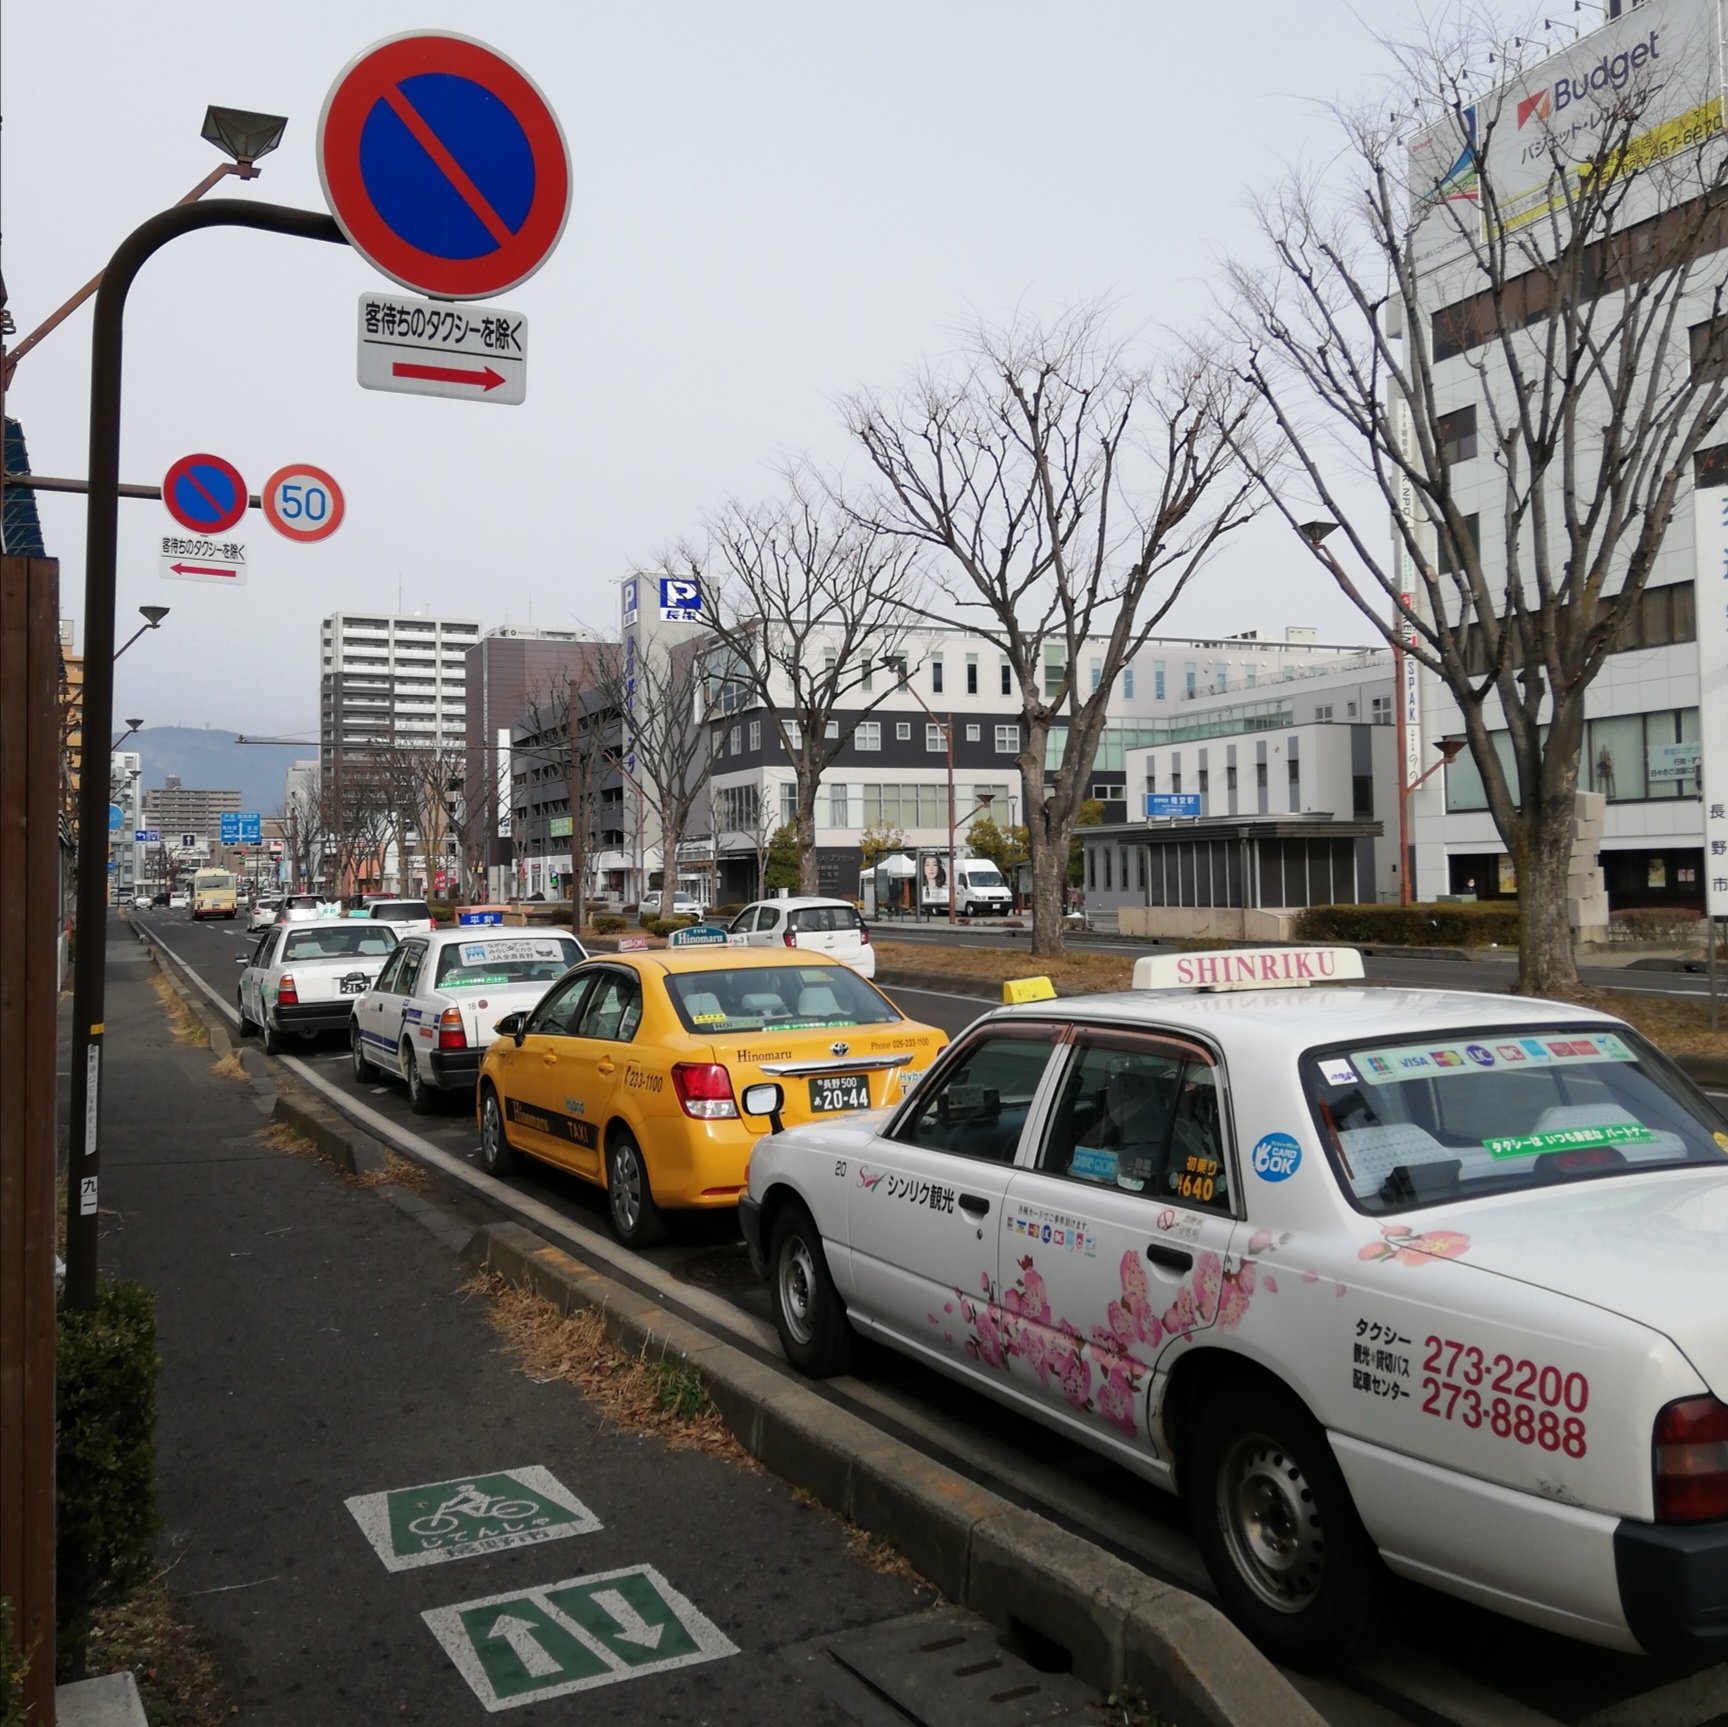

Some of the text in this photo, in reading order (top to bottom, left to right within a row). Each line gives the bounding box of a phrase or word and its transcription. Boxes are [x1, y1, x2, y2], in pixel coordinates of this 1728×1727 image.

[1555, 31, 1659, 112] Budget
[365, 301, 522, 352] 客待ちのタクシーを除く
[282, 484, 326, 521] 50
[162, 537, 245, 561] 客待ちのタクシーを除く
[667, 580, 697, 607] P
[1408, 662, 1416, 721] SPAK
[1709, 805, 1728, 892] 長野市
[678, 933, 723, 945] Hinomaru
[1177, 951, 1336, 985] SHINRIKU
[737, 1049, 792, 1063] Hinomaru
[871, 1041, 891, 1051] Phone
[1400, 1056, 1430, 1068] VISA
[629, 1070, 664, 1093] 233-1100
[823, 1077, 857, 1090] 長野 500
[823, 1088, 869, 1110] 20-44
[512, 1101, 589, 1143] Hinomaru TAXI
[1492, 1135, 1544, 1153] タクシーは
[1606, 1125, 1649, 1138] パートナー
[1186, 1154, 1218, 1177] 初乗り
[1271, 1147, 1298, 1159] CARD
[835, 1160, 847, 1178] 20
[888, 1175, 955, 1214] シンリク観光
[1177, 1174, 1214, 1202] ¥640
[1355, 1318, 1412, 1345] タクシー
[1352, 1368, 1411, 1400] 配車センター
[421, 1517, 550, 1548] じてんしゃ
